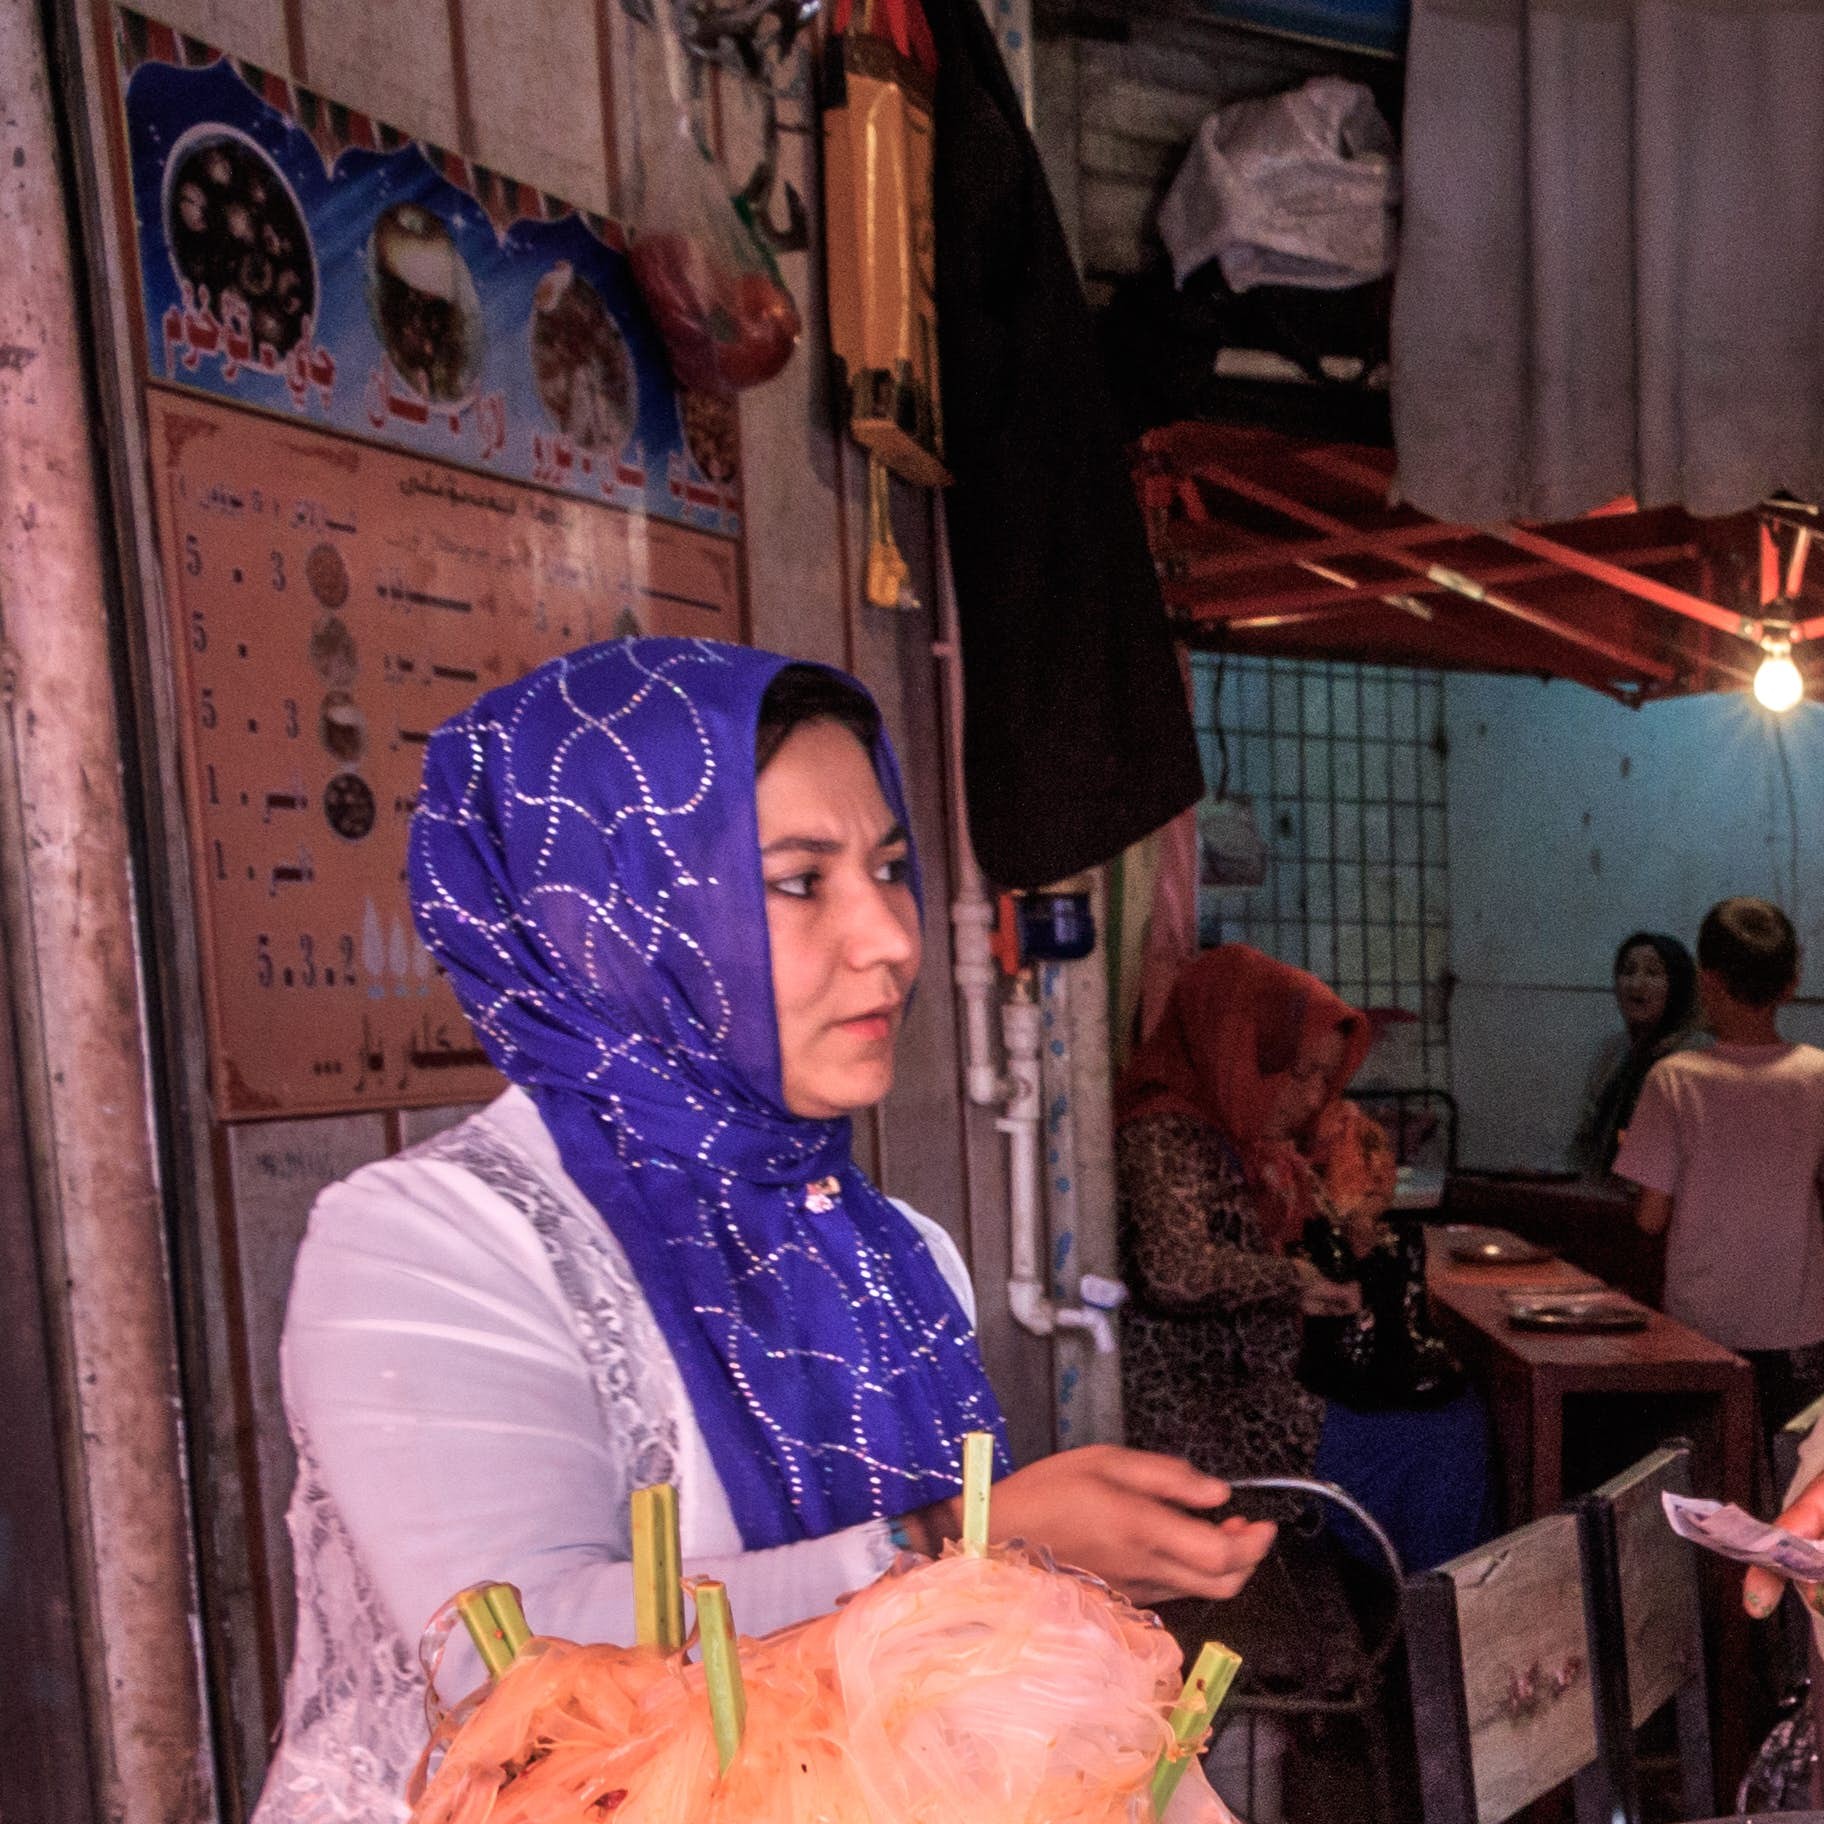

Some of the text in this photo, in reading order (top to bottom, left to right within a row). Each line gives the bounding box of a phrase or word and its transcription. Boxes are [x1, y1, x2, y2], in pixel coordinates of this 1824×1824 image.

[185, 533, 203, 577] 5
[191, 611, 208, 653] 5
[200, 688, 217, 731] 5
